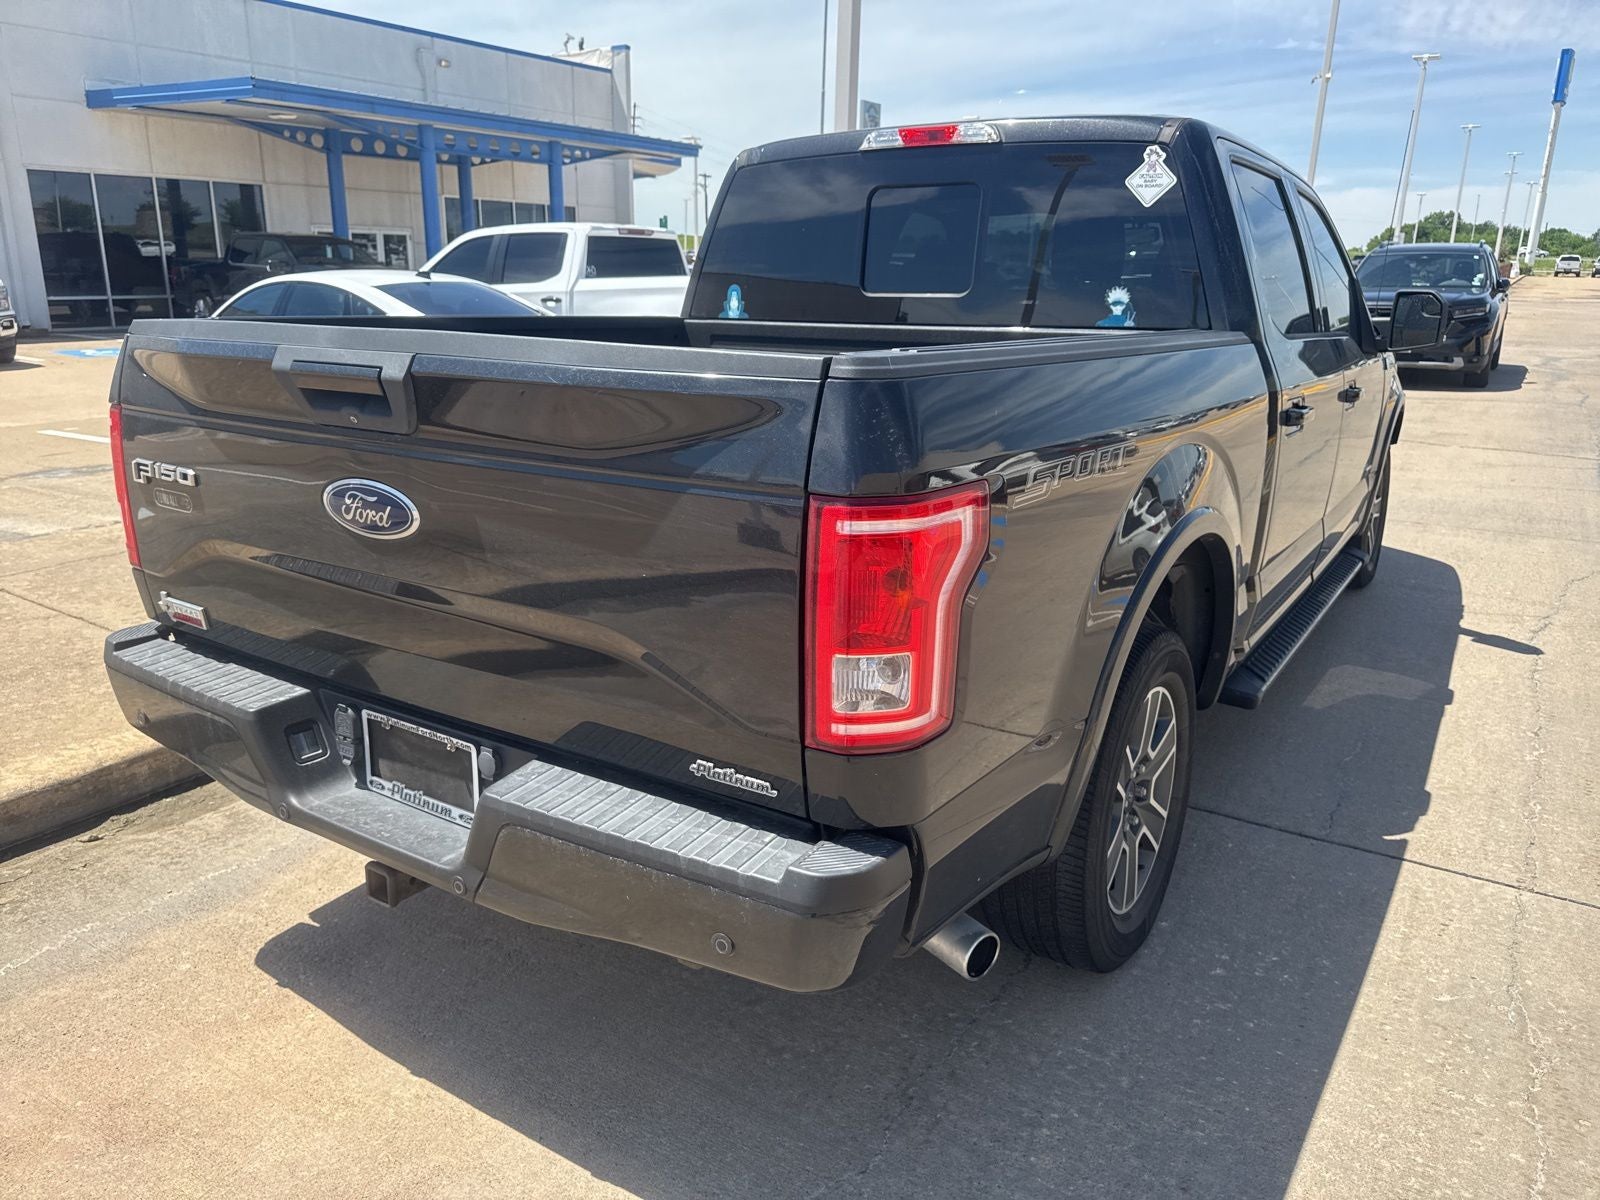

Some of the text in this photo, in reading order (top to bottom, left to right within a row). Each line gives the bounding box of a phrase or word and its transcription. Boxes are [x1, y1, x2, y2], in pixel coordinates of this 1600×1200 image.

[1012, 441, 1135, 509] SPORT
[342, 491, 391, 528] Ford
[689, 759, 777, 797] Platinum
[386, 782, 457, 820] Platinum
